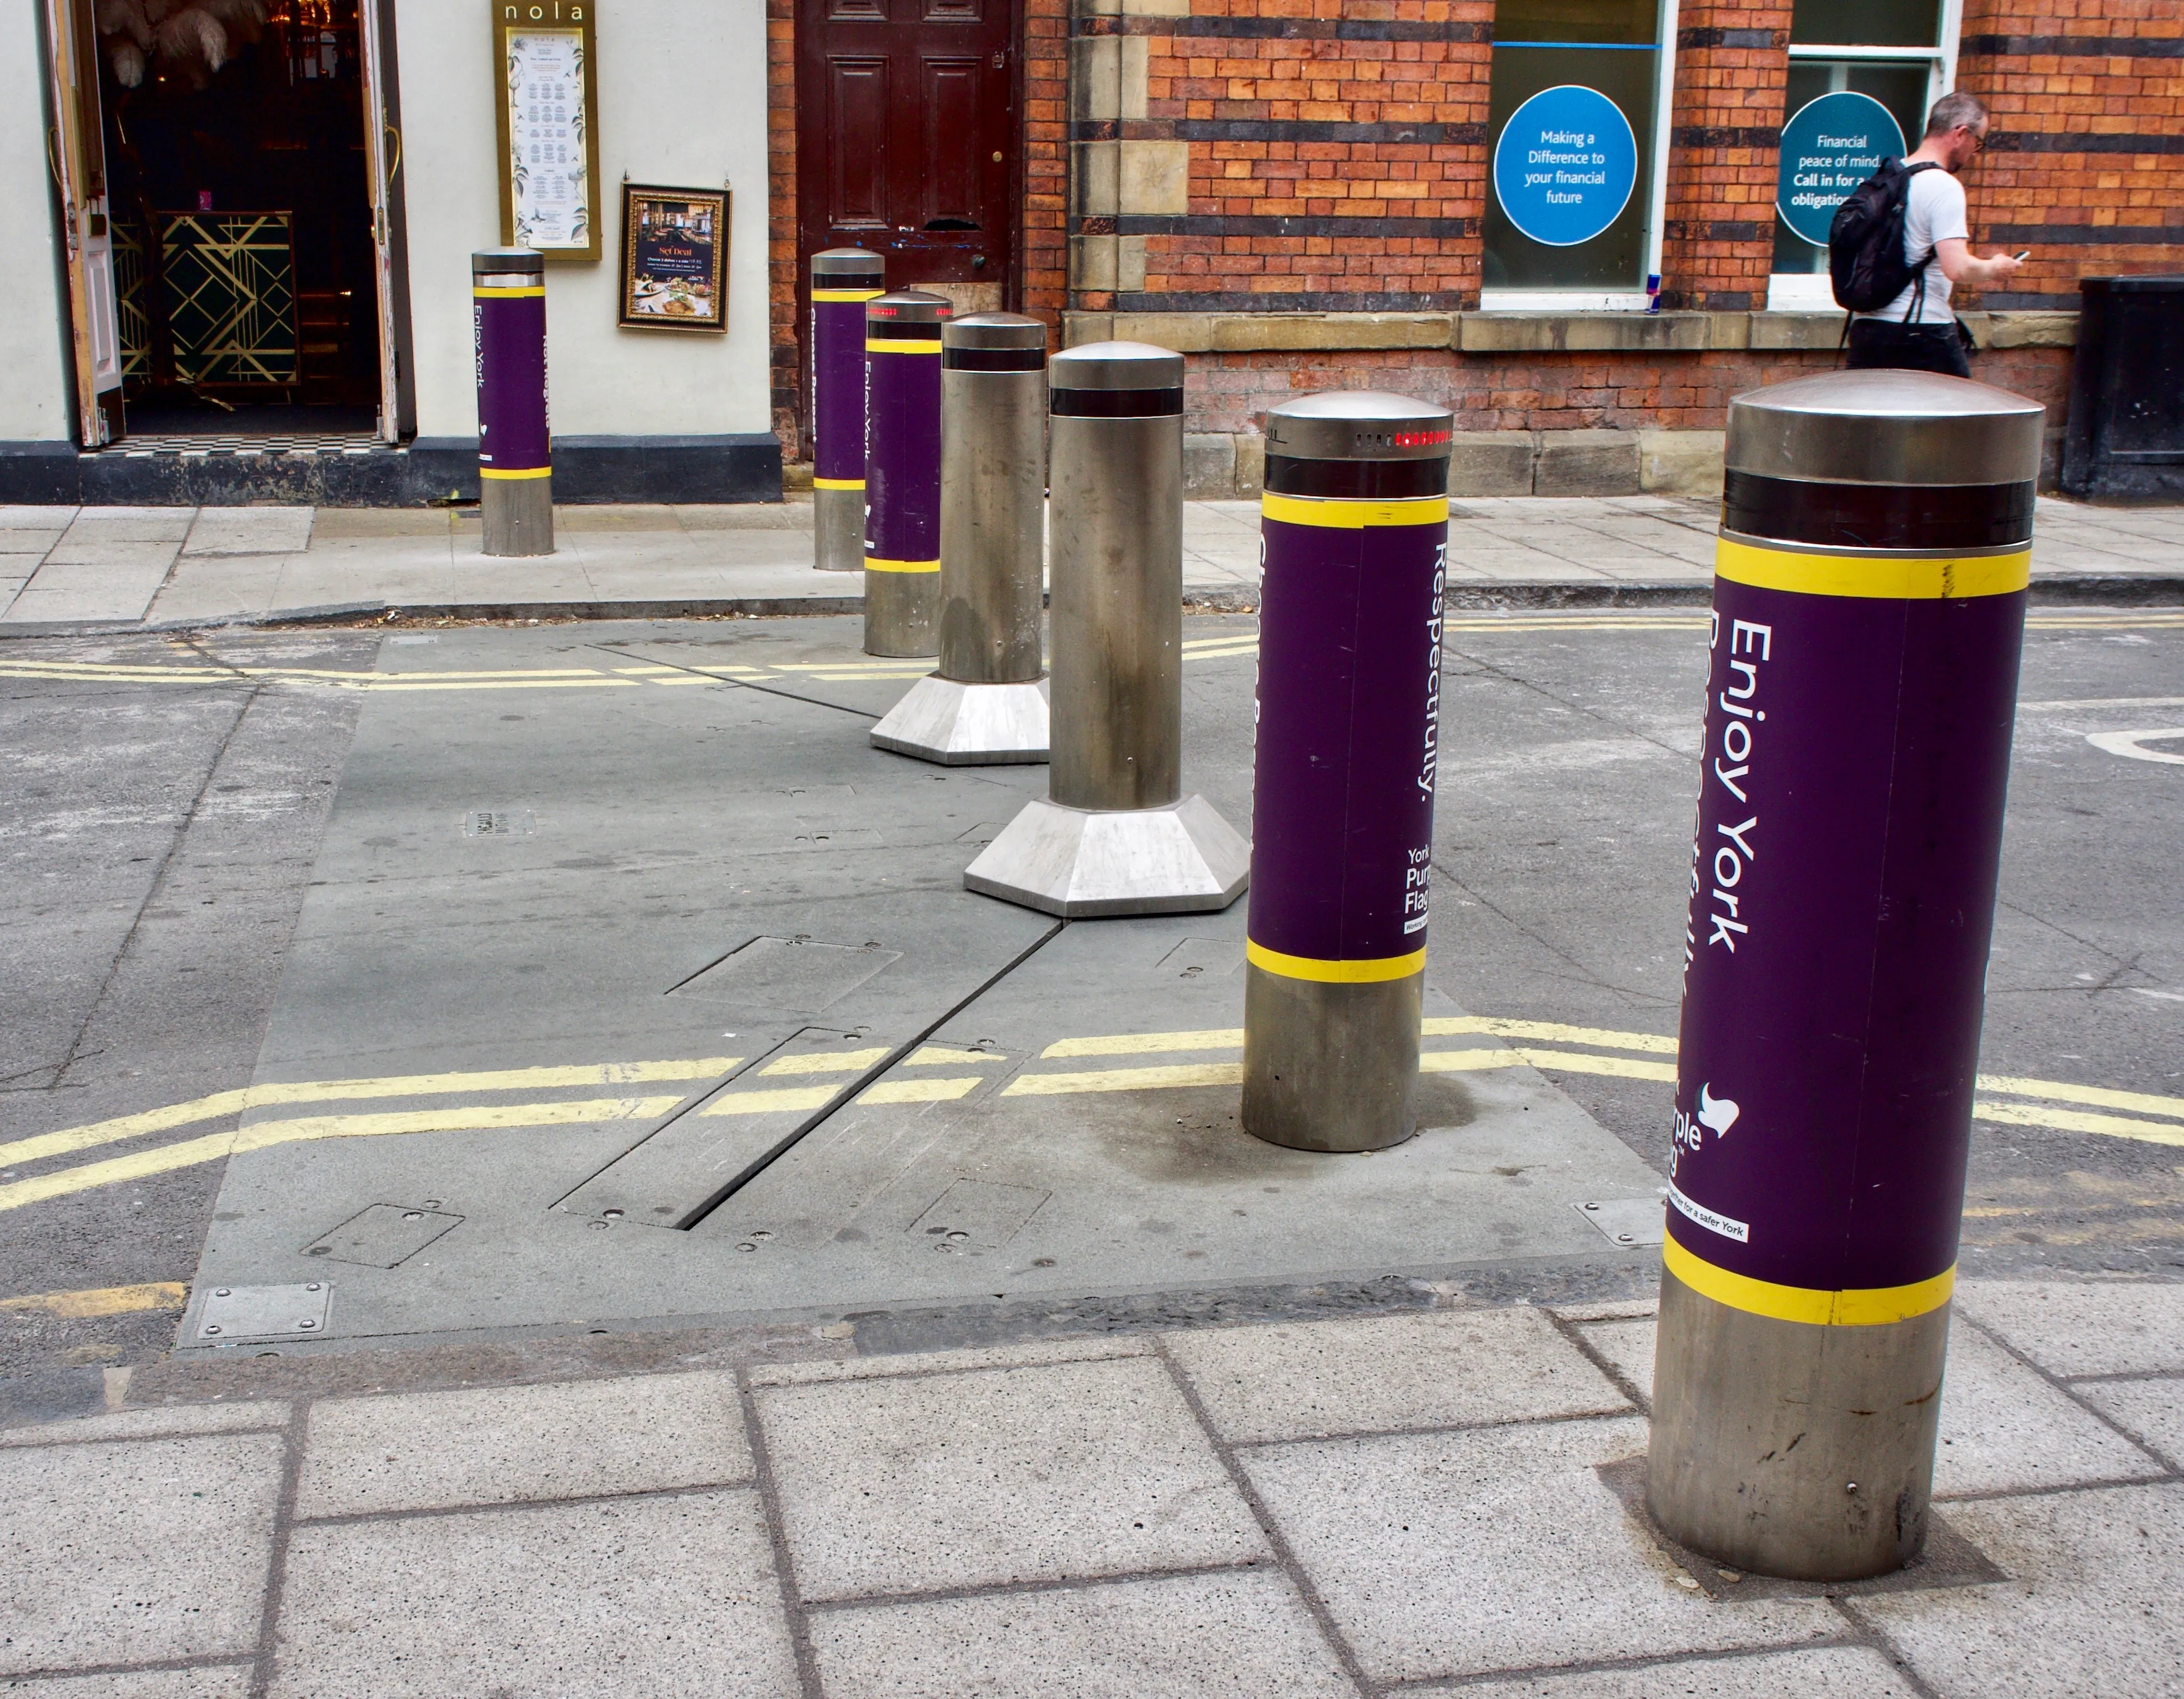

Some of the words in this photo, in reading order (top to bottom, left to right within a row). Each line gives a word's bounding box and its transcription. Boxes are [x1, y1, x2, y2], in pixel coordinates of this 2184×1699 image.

[505, 1, 582, 20] nola
[1541, 130, 1585, 148] Making
[1587, 133, 1595, 144] a
[1817, 134, 1868, 148] Financial
[1528, 150, 1589, 164] Difference
[1592, 152, 1605, 164] to
[1798, 156, 1832, 171] peace
[1834, 154, 1849, 168] of
[1523, 172, 1553, 187] your
[1556, 170, 1606, 185] financial
[1793, 173, 1818, 187] Call
[1821, 173, 1833, 187] in
[1836, 173, 1855, 187] for
[1546, 190, 1583, 204] future
[474, 305, 483, 350] Enjoy
[476, 352, 485, 388] York
[1417, 541, 1448, 803] Respectfully.
[1715, 619, 1772, 803] Enjoy
[1408, 844, 1429, 864] York
[1708, 816, 1757, 954] York
[1404, 889, 1429, 914] Flag
[1684, 1201, 1693, 1213] for
[1699, 1213, 1720, 1227] safer
[1722, 1221, 1744, 1236] York
